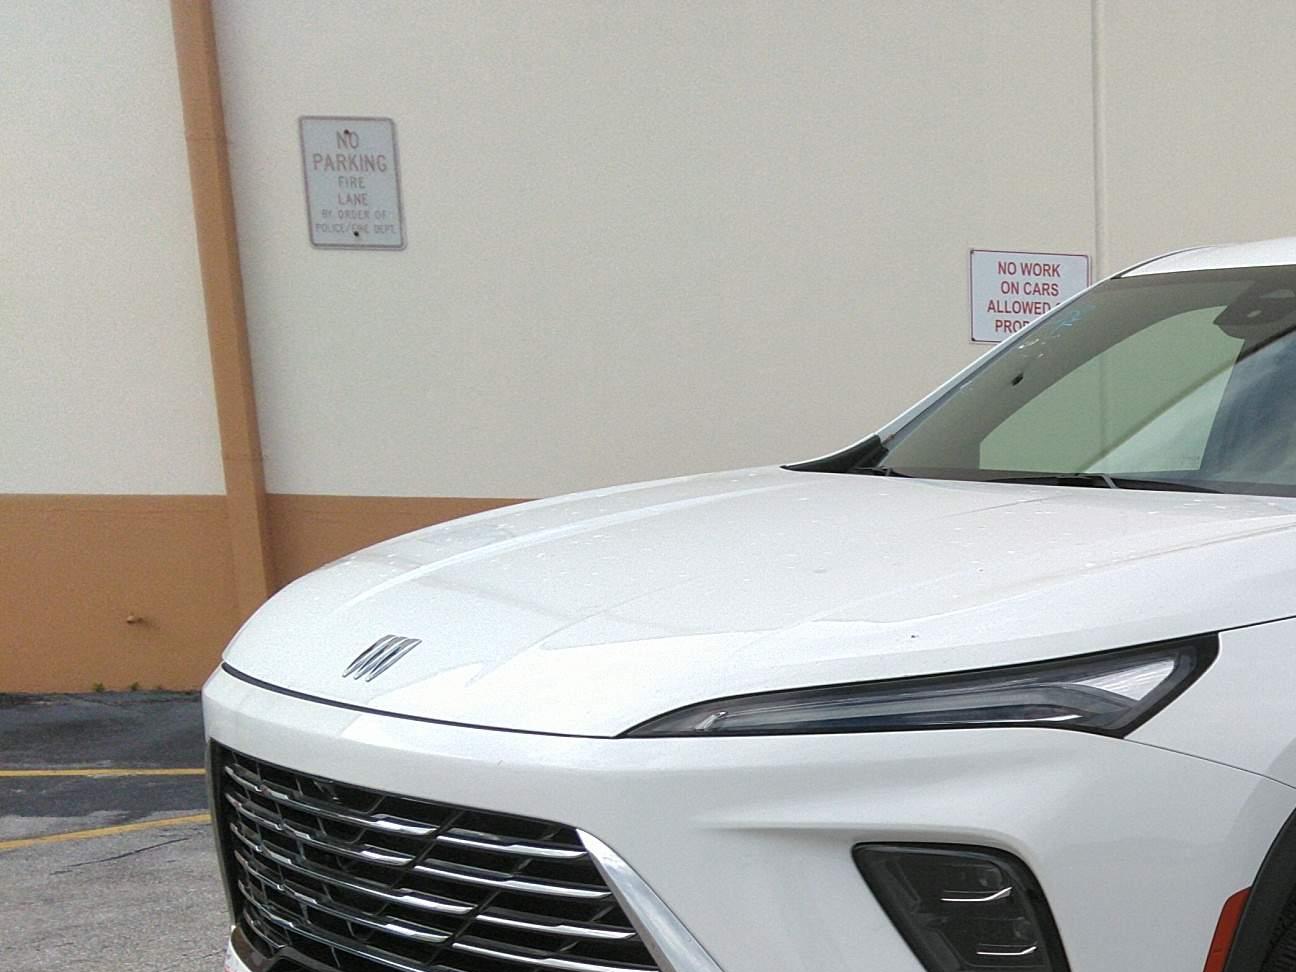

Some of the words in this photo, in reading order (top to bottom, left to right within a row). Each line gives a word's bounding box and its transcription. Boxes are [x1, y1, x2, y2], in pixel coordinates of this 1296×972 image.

[336, 130, 360, 149] NO
[312, 152, 388, 173] PARKING
[337, 175, 366, 189] FIRE
[337, 192, 369, 207] LANE
[338, 210, 370, 220] ORDER
[998, 261, 1017, 275] NO
[1020, 262, 1061, 278] WORK
[1000, 280, 1019, 295] ON
[1023, 282, 1060, 297] CARS
[987, 299, 1051, 315] ALLOWED
